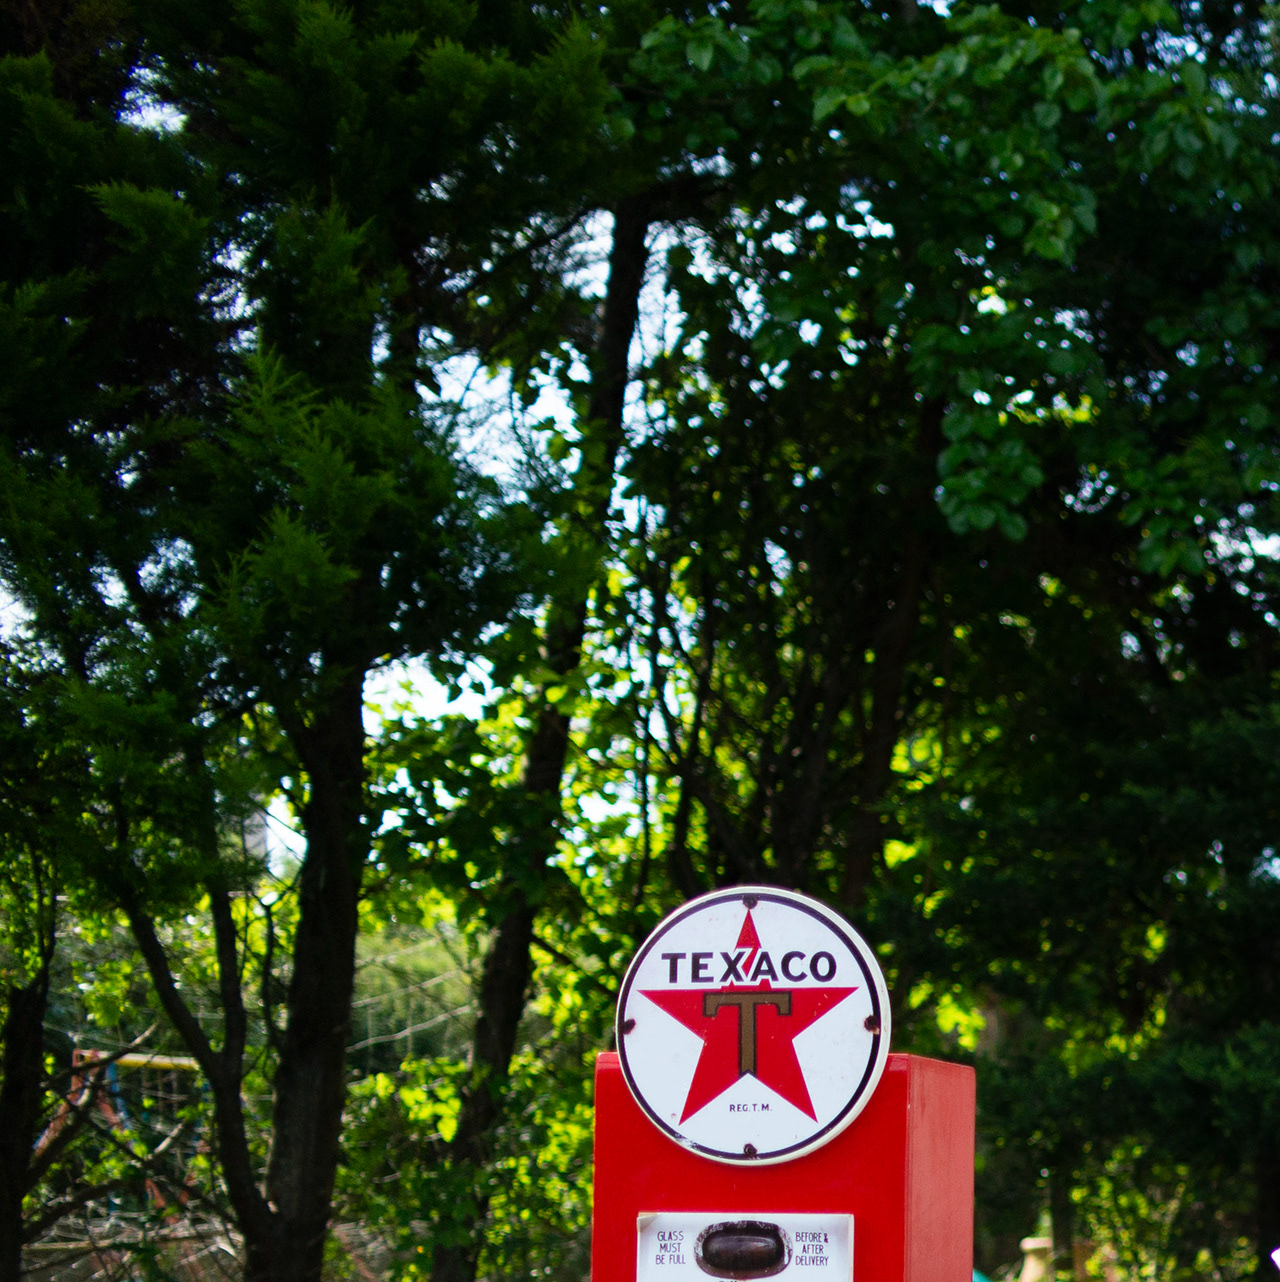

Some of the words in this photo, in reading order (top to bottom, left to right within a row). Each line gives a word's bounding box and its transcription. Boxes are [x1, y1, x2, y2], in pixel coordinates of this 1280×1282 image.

[660, 950, 837, 984] TEXACO
[657, 1231, 684, 1242] GLASS
[795, 1232, 822, 1243] BEFORE
[659, 1243, 682, 1253] MUST
[801, 1244, 824, 1255] AFTER
[655, 1254, 666, 1265] BE
[668, 1254, 686, 1265] FULL
[795, 1255, 829, 1267] DELIVERY
